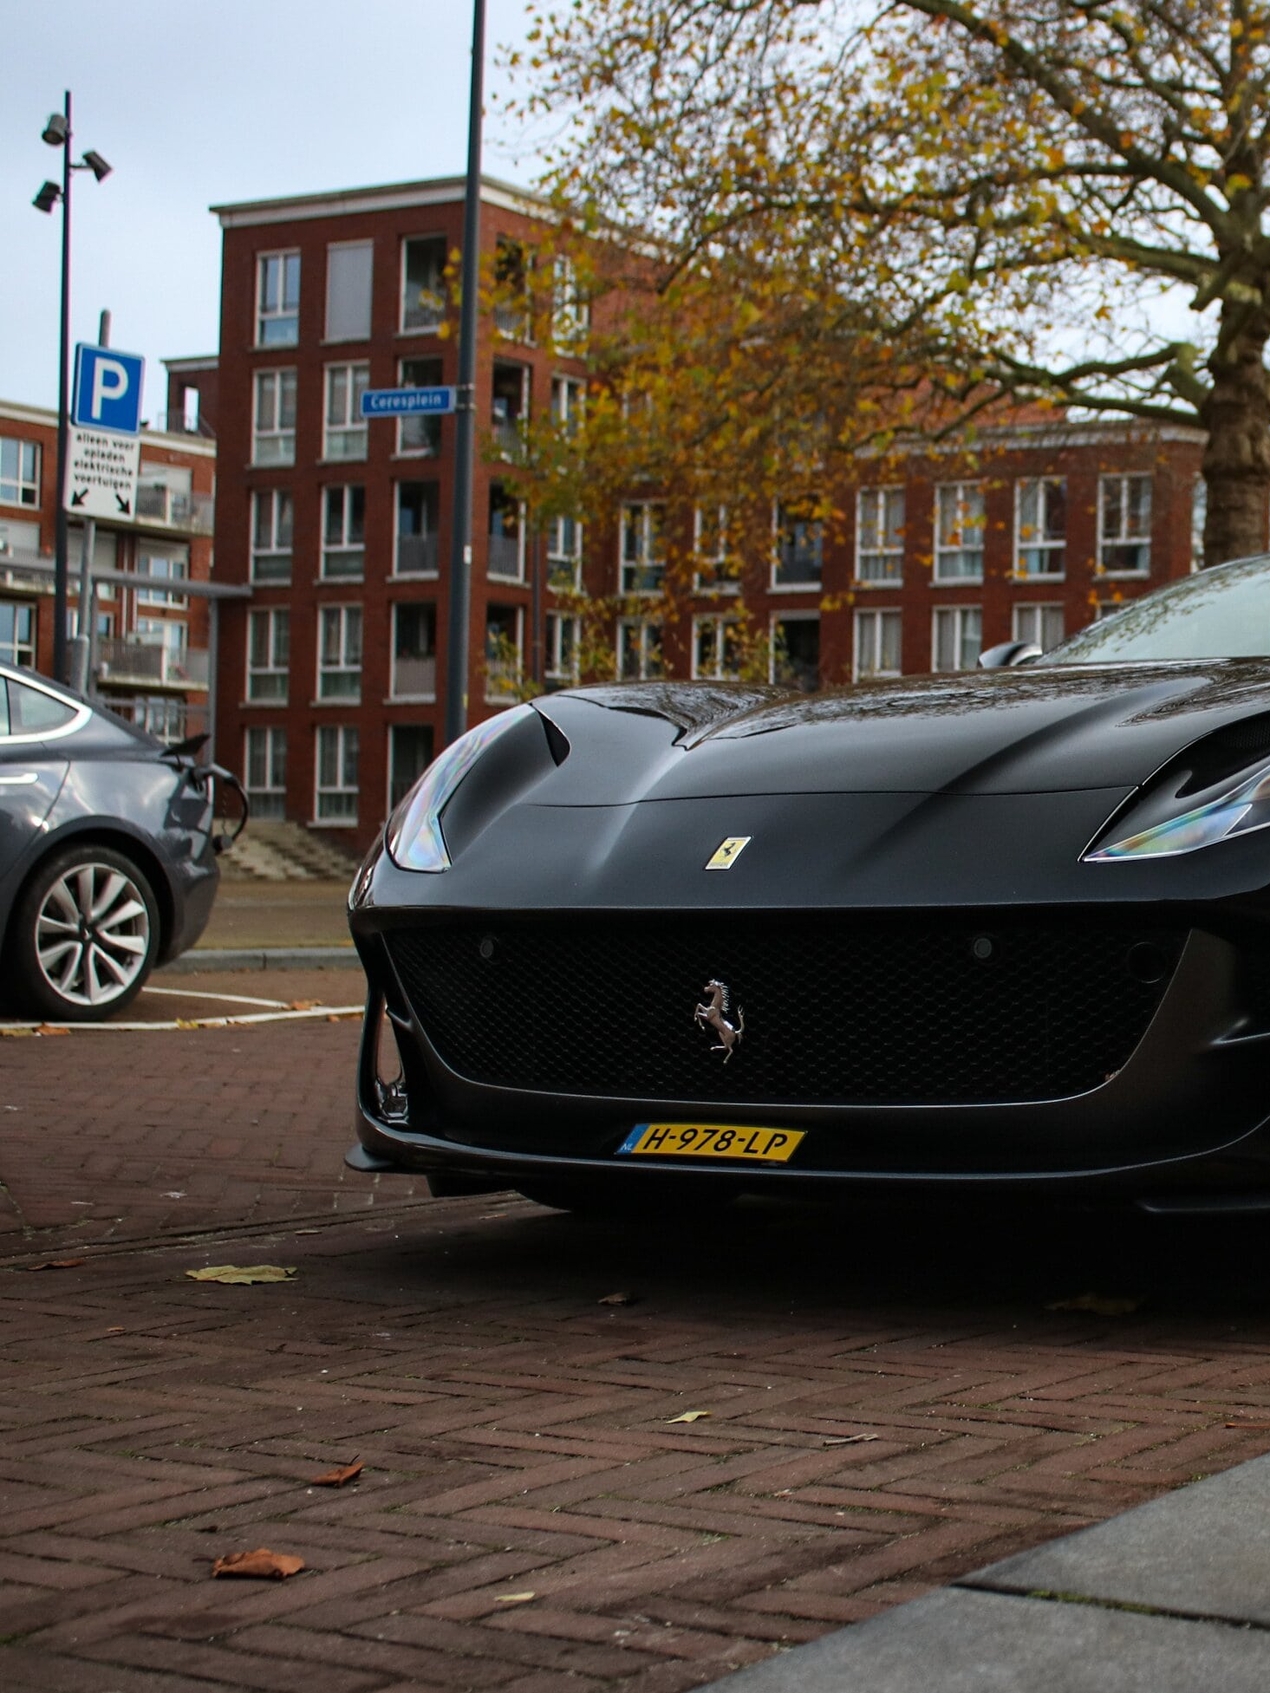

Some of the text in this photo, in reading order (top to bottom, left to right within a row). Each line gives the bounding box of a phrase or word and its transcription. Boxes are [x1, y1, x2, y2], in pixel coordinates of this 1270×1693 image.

[92, 357, 129, 420] P
[371, 394, 442, 410] Ceresplein
[76, 433, 109, 447] alleen
[643, 1128, 788, 1155] H-978-LP
